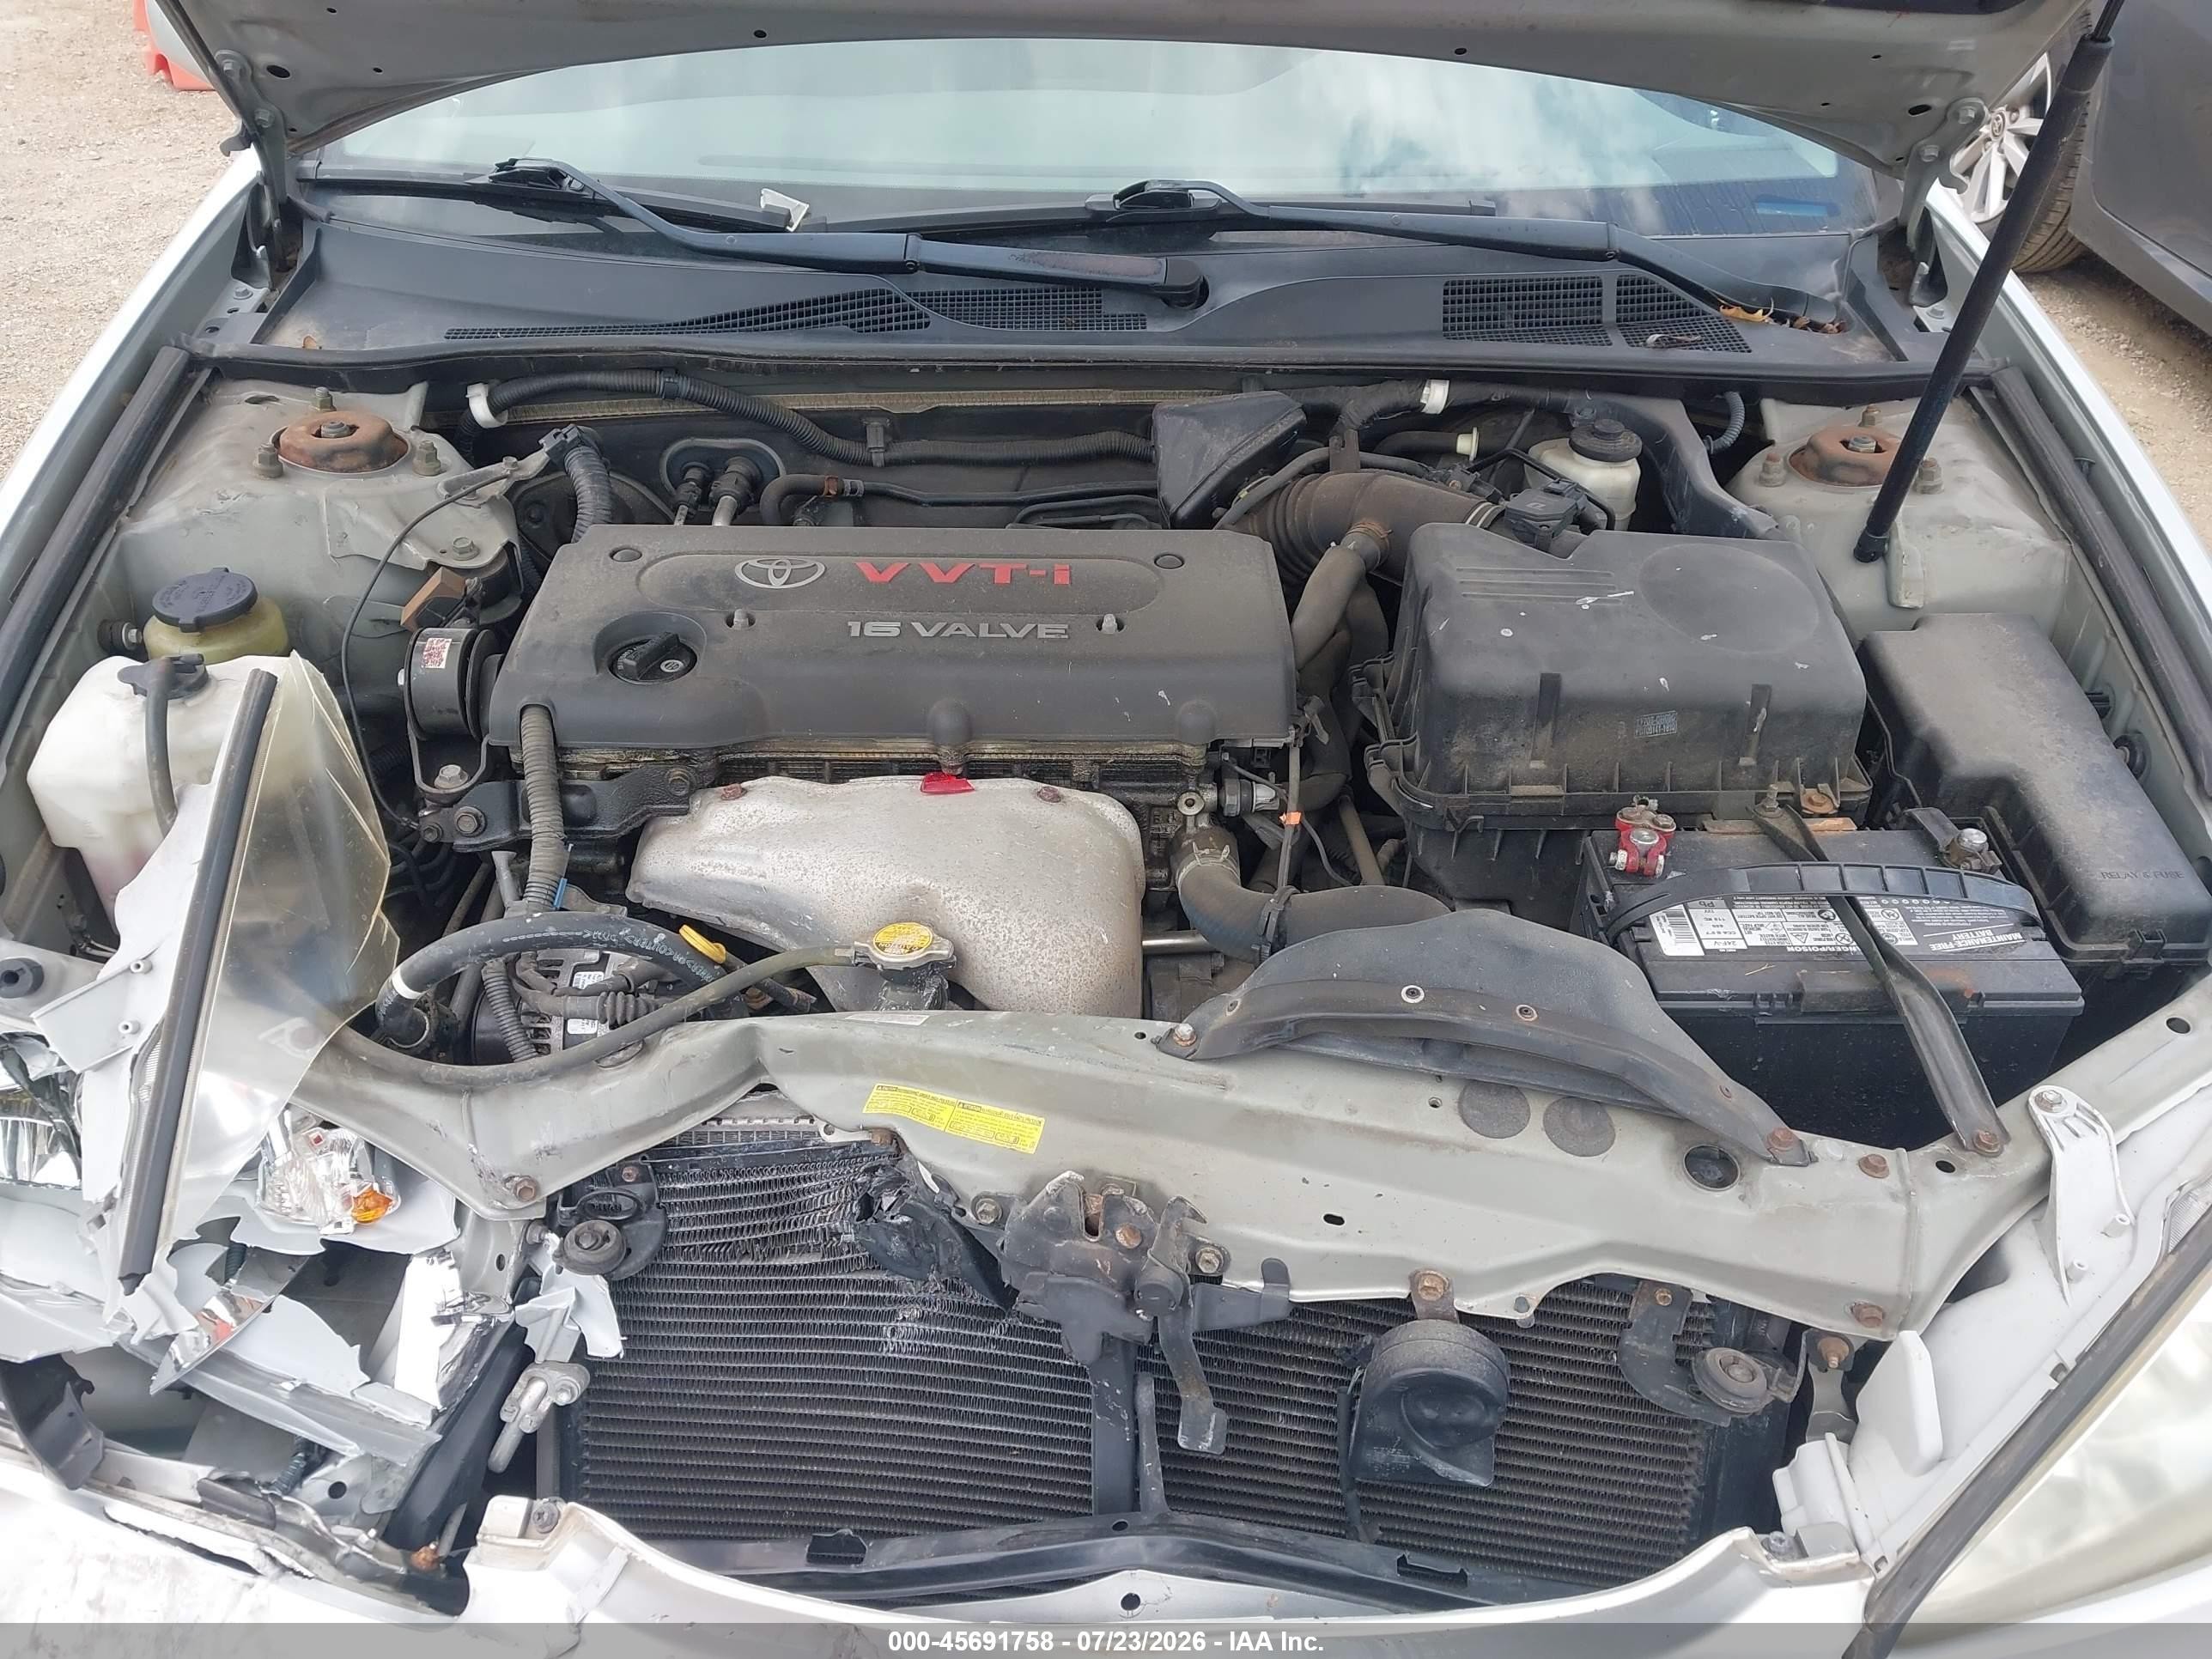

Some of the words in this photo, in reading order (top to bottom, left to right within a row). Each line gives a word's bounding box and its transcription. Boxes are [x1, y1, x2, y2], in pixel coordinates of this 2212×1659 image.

[854, 562, 1072, 586] VVT-i
[847, 620, 902, 638] 16
[910, 621, 1070, 640] VALVE
[2100, 871, 2138, 879] RELAY
[2142, 871, 2150, 879] &
[2153, 871, 2185, 879] FUSE
[1929, 932, 2023, 951] MAINTENANCE-FREE
[1951, 929, 1994, 941] BATTERY
